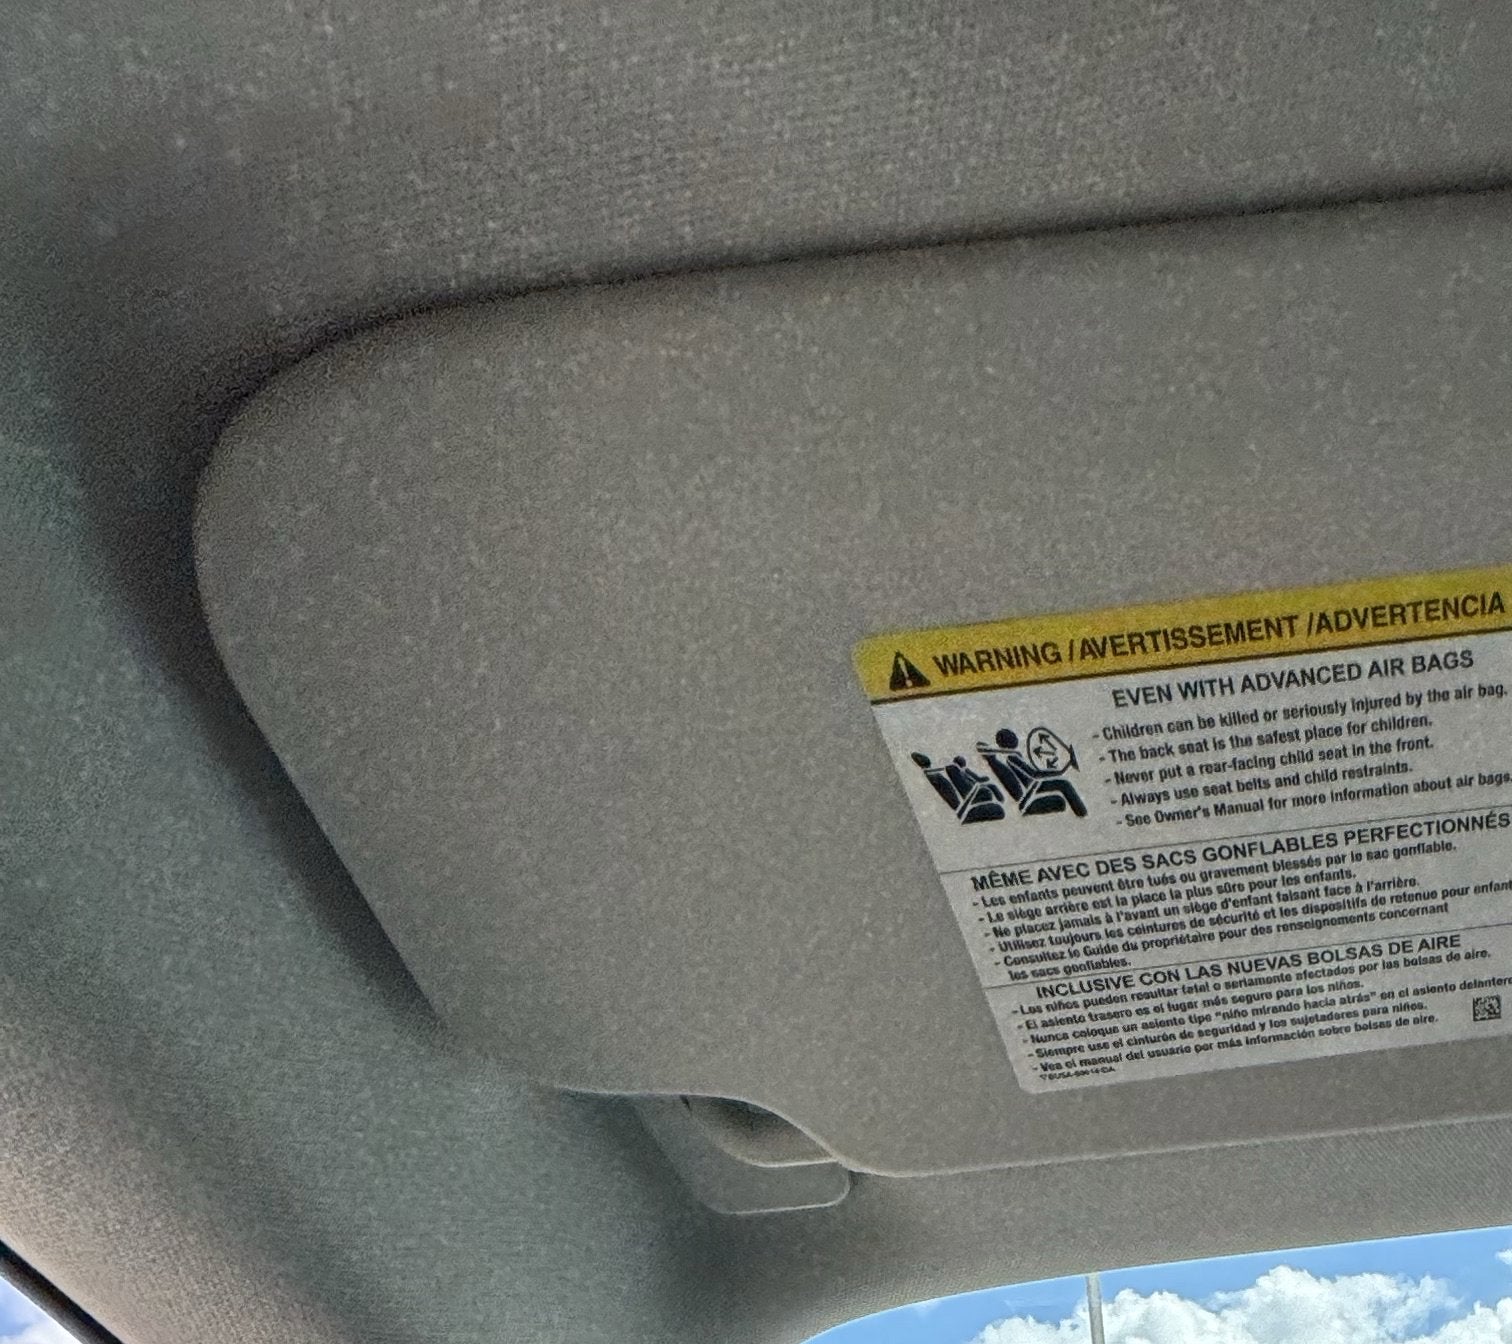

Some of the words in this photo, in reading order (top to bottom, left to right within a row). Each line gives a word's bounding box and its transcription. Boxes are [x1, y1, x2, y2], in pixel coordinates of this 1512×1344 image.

[932, 643, 1063, 678] WARNING
[1064, 615, 1300, 663] /AVERTISSEMENT
[1305, 591, 1505, 635] /ADVERTENCIA
[1111, 684, 1172, 707] EVEN
[1177, 677, 1234, 699] WITH
[1239, 662, 1361, 692] ADVANCED
[1367, 658, 1404, 678] AIR
[1411, 650, 1473, 673] BAGS
[1101, 721, 1163, 740] Children
[1166, 720, 1193, 733] can
[1197, 715, 1215, 729] be
[1218, 710, 1259, 727] killed
[1263, 710, 1278, 722] or
[1282, 699, 1347, 723] seriously
[1351, 693, 1401, 715] injured
[1405, 691, 1422, 708] by
[1427, 688, 1449, 703] the
[1454, 685, 1472, 700] air
[1478, 681, 1507, 700] bag.
[1107, 747, 1135, 762] The
[1138, 743, 1174, 758] back
[1177, 739, 1208, 754] seat
[1212, 737, 1225, 750] is
[1229, 734, 1252, 748] the
[1256, 728, 1300, 745] safest
[1304, 723, 1342, 743] place
[1346, 721, 1366, 735] for
[1371, 713, 1431, 732] children.
[1113, 768, 1154, 784] Never
[1157, 765, 1182, 782] put
[1185, 766, 1194, 775] a
[1198, 754, 1276, 777] rear-facing
[1279, 749, 1313, 764] child
[1318, 745, 1347, 760] seat
[1352, 743, 1364, 756] in
[1369, 740, 1391, 754] the
[1396, 735, 1432, 751] front.
[1119, 788, 1170, 808] Always
[1173, 787, 1199, 798] use
[1201, 781, 1232, 795] seat
[1235, 776, 1270, 791] belts
[1274, 773, 1300, 787] and
[1303, 768, 1337, 783] child
[1341, 759, 1411, 779] restraints.
[1124, 812, 1151, 825] See
[1153, 805, 1210, 822] Owner's
[1213, 799, 1264, 815] Manual
[1267, 796, 1287, 809] for
[1291, 794, 1326, 806] more
[1330, 782, 1408, 802] information
[1413, 777, 1451, 792] about
[1456, 774, 1473, 787] air
[1478, 770, 1512, 788] bags.
[968, 866, 1032, 890] MÊME
[1034, 863, 1090, 882] AVEC
[1094, 857, 1136, 875] DES
[1141, 850, 1196, 869] SACS
[1201, 833, 1337, 862] GONFLABLES
[1343, 808, 1509, 845] PERFECTIONNÉS
[1035, 975, 1134, 997] INCLUSIVE
[1138, 969, 1180, 985] CON
[1184, 964, 1222, 979] LAS
[1226, 954, 1301, 974] NUEVAS
[1307, 944, 1382, 964] BOLSAS
[1388, 940, 1412, 954] DE
[1417, 935, 1460, 951] AIRE
